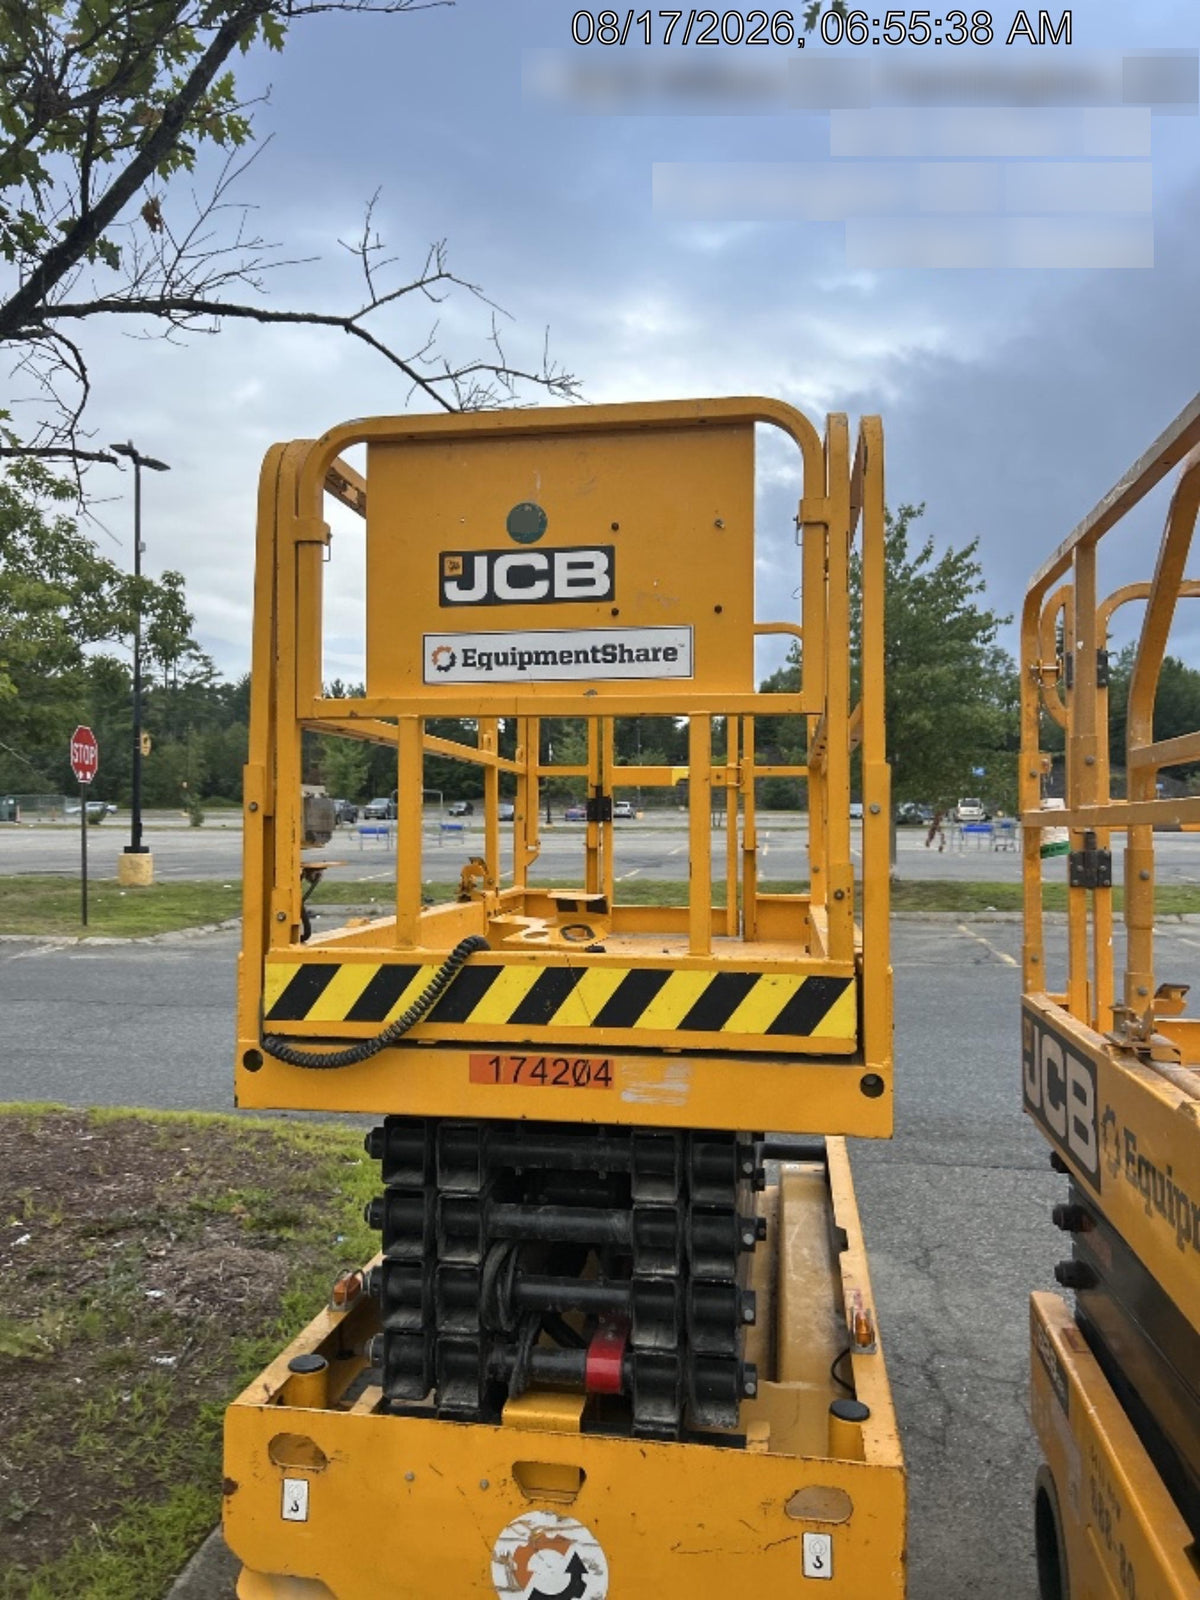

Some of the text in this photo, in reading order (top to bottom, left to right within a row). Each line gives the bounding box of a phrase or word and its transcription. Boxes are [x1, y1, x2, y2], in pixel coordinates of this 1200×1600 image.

[443, 550, 611, 602] JCB
[461, 643, 678, 671] EquipmentShare
[72, 742, 95, 766] STOP
[488, 1056, 613, 1088] 174204
[1024, 1024, 1097, 1174] JCB
